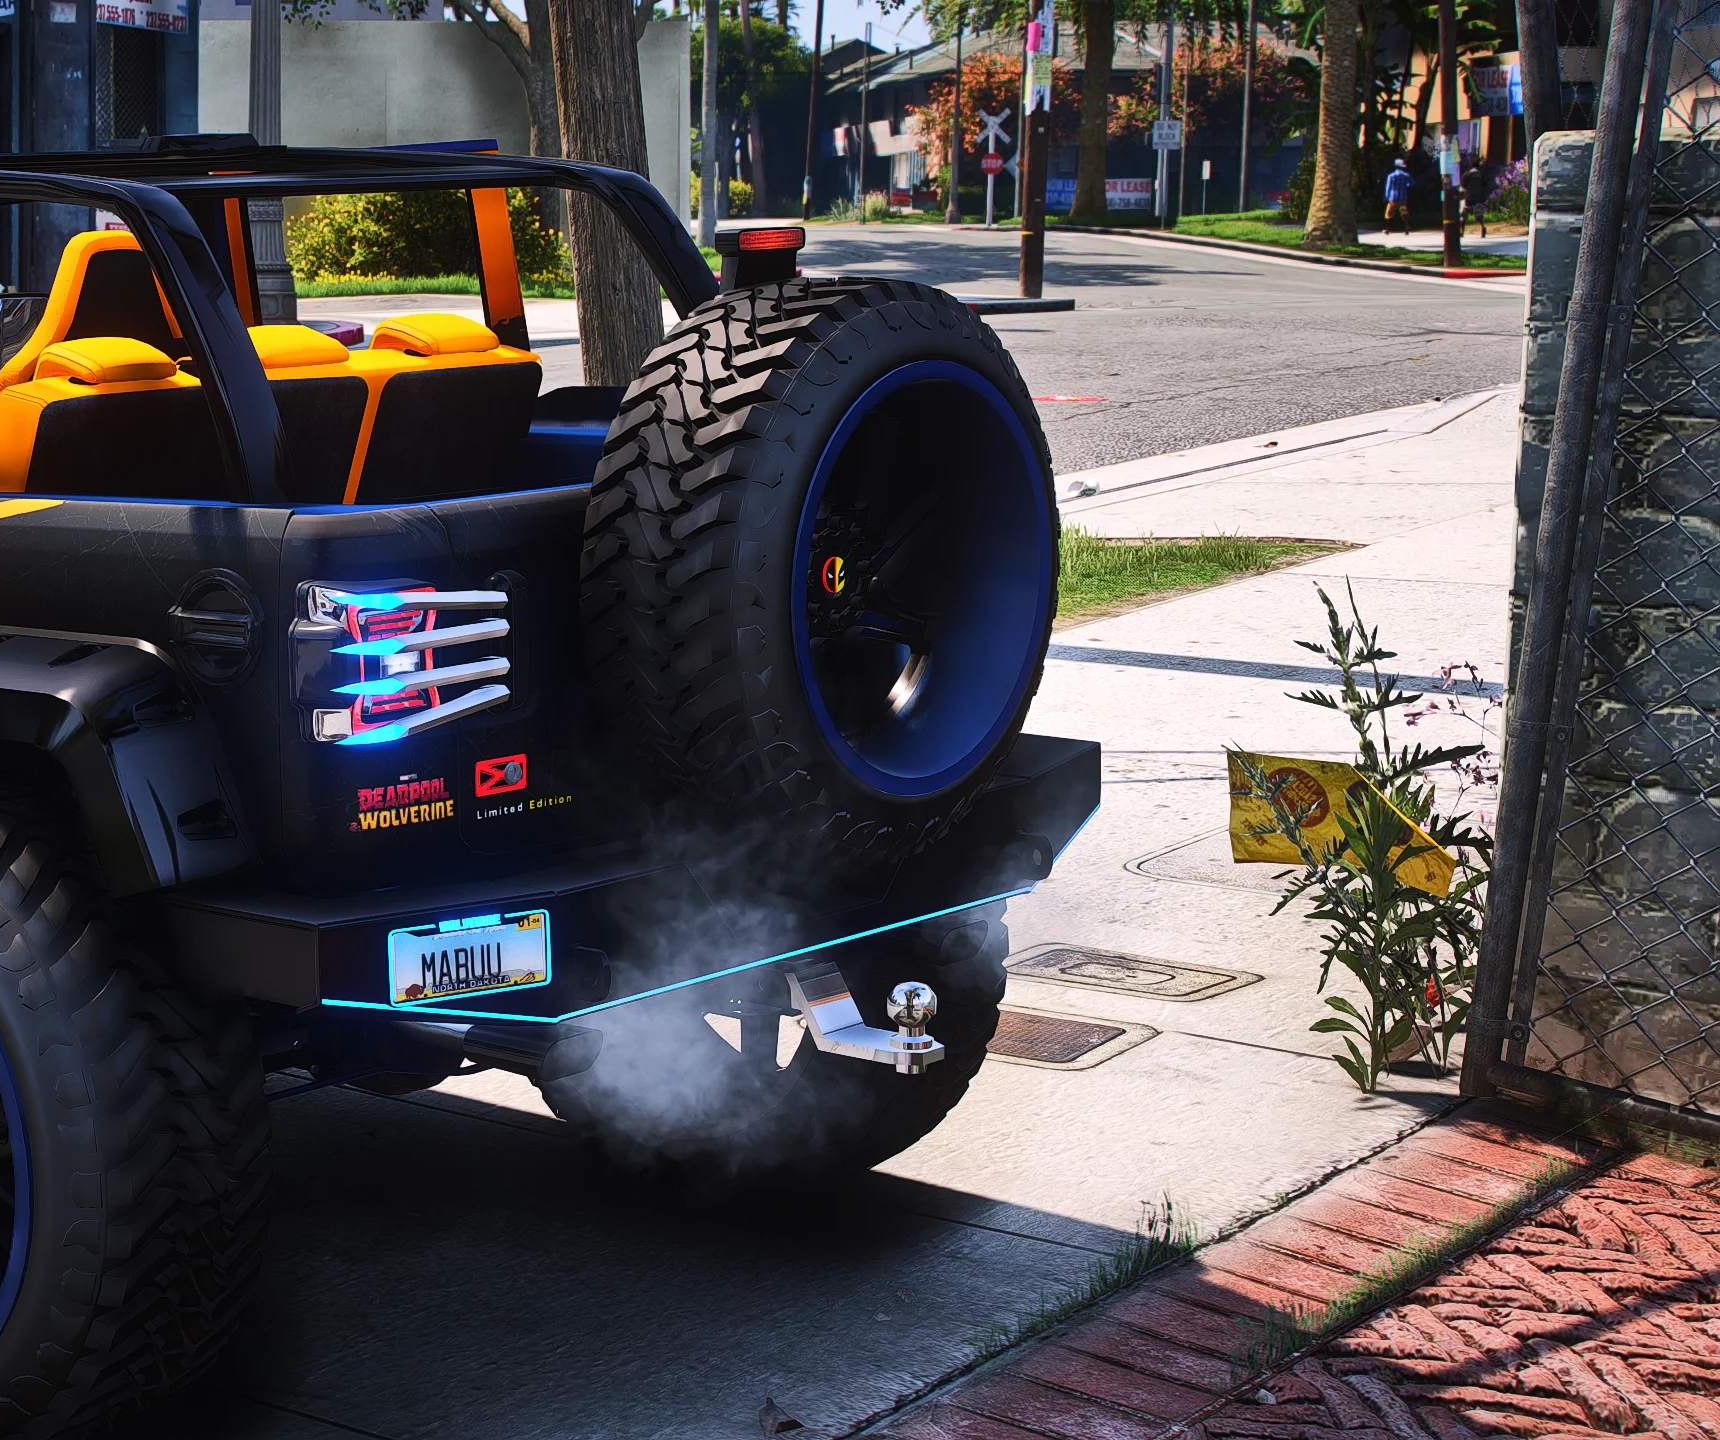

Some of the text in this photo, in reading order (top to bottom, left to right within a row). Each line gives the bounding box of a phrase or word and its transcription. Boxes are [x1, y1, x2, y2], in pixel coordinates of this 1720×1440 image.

[982, 159, 1003, 168] STOP
[1121, 181, 1151, 192] LEASE
[358, 777, 450, 812] DEADPOOL
[477, 794, 573, 820] Limited Edition
[359, 800, 454, 831] WOLVERINE
[421, 942, 502, 990] MABUU
[432, 975, 511, 993] NORTH DAKOTA
